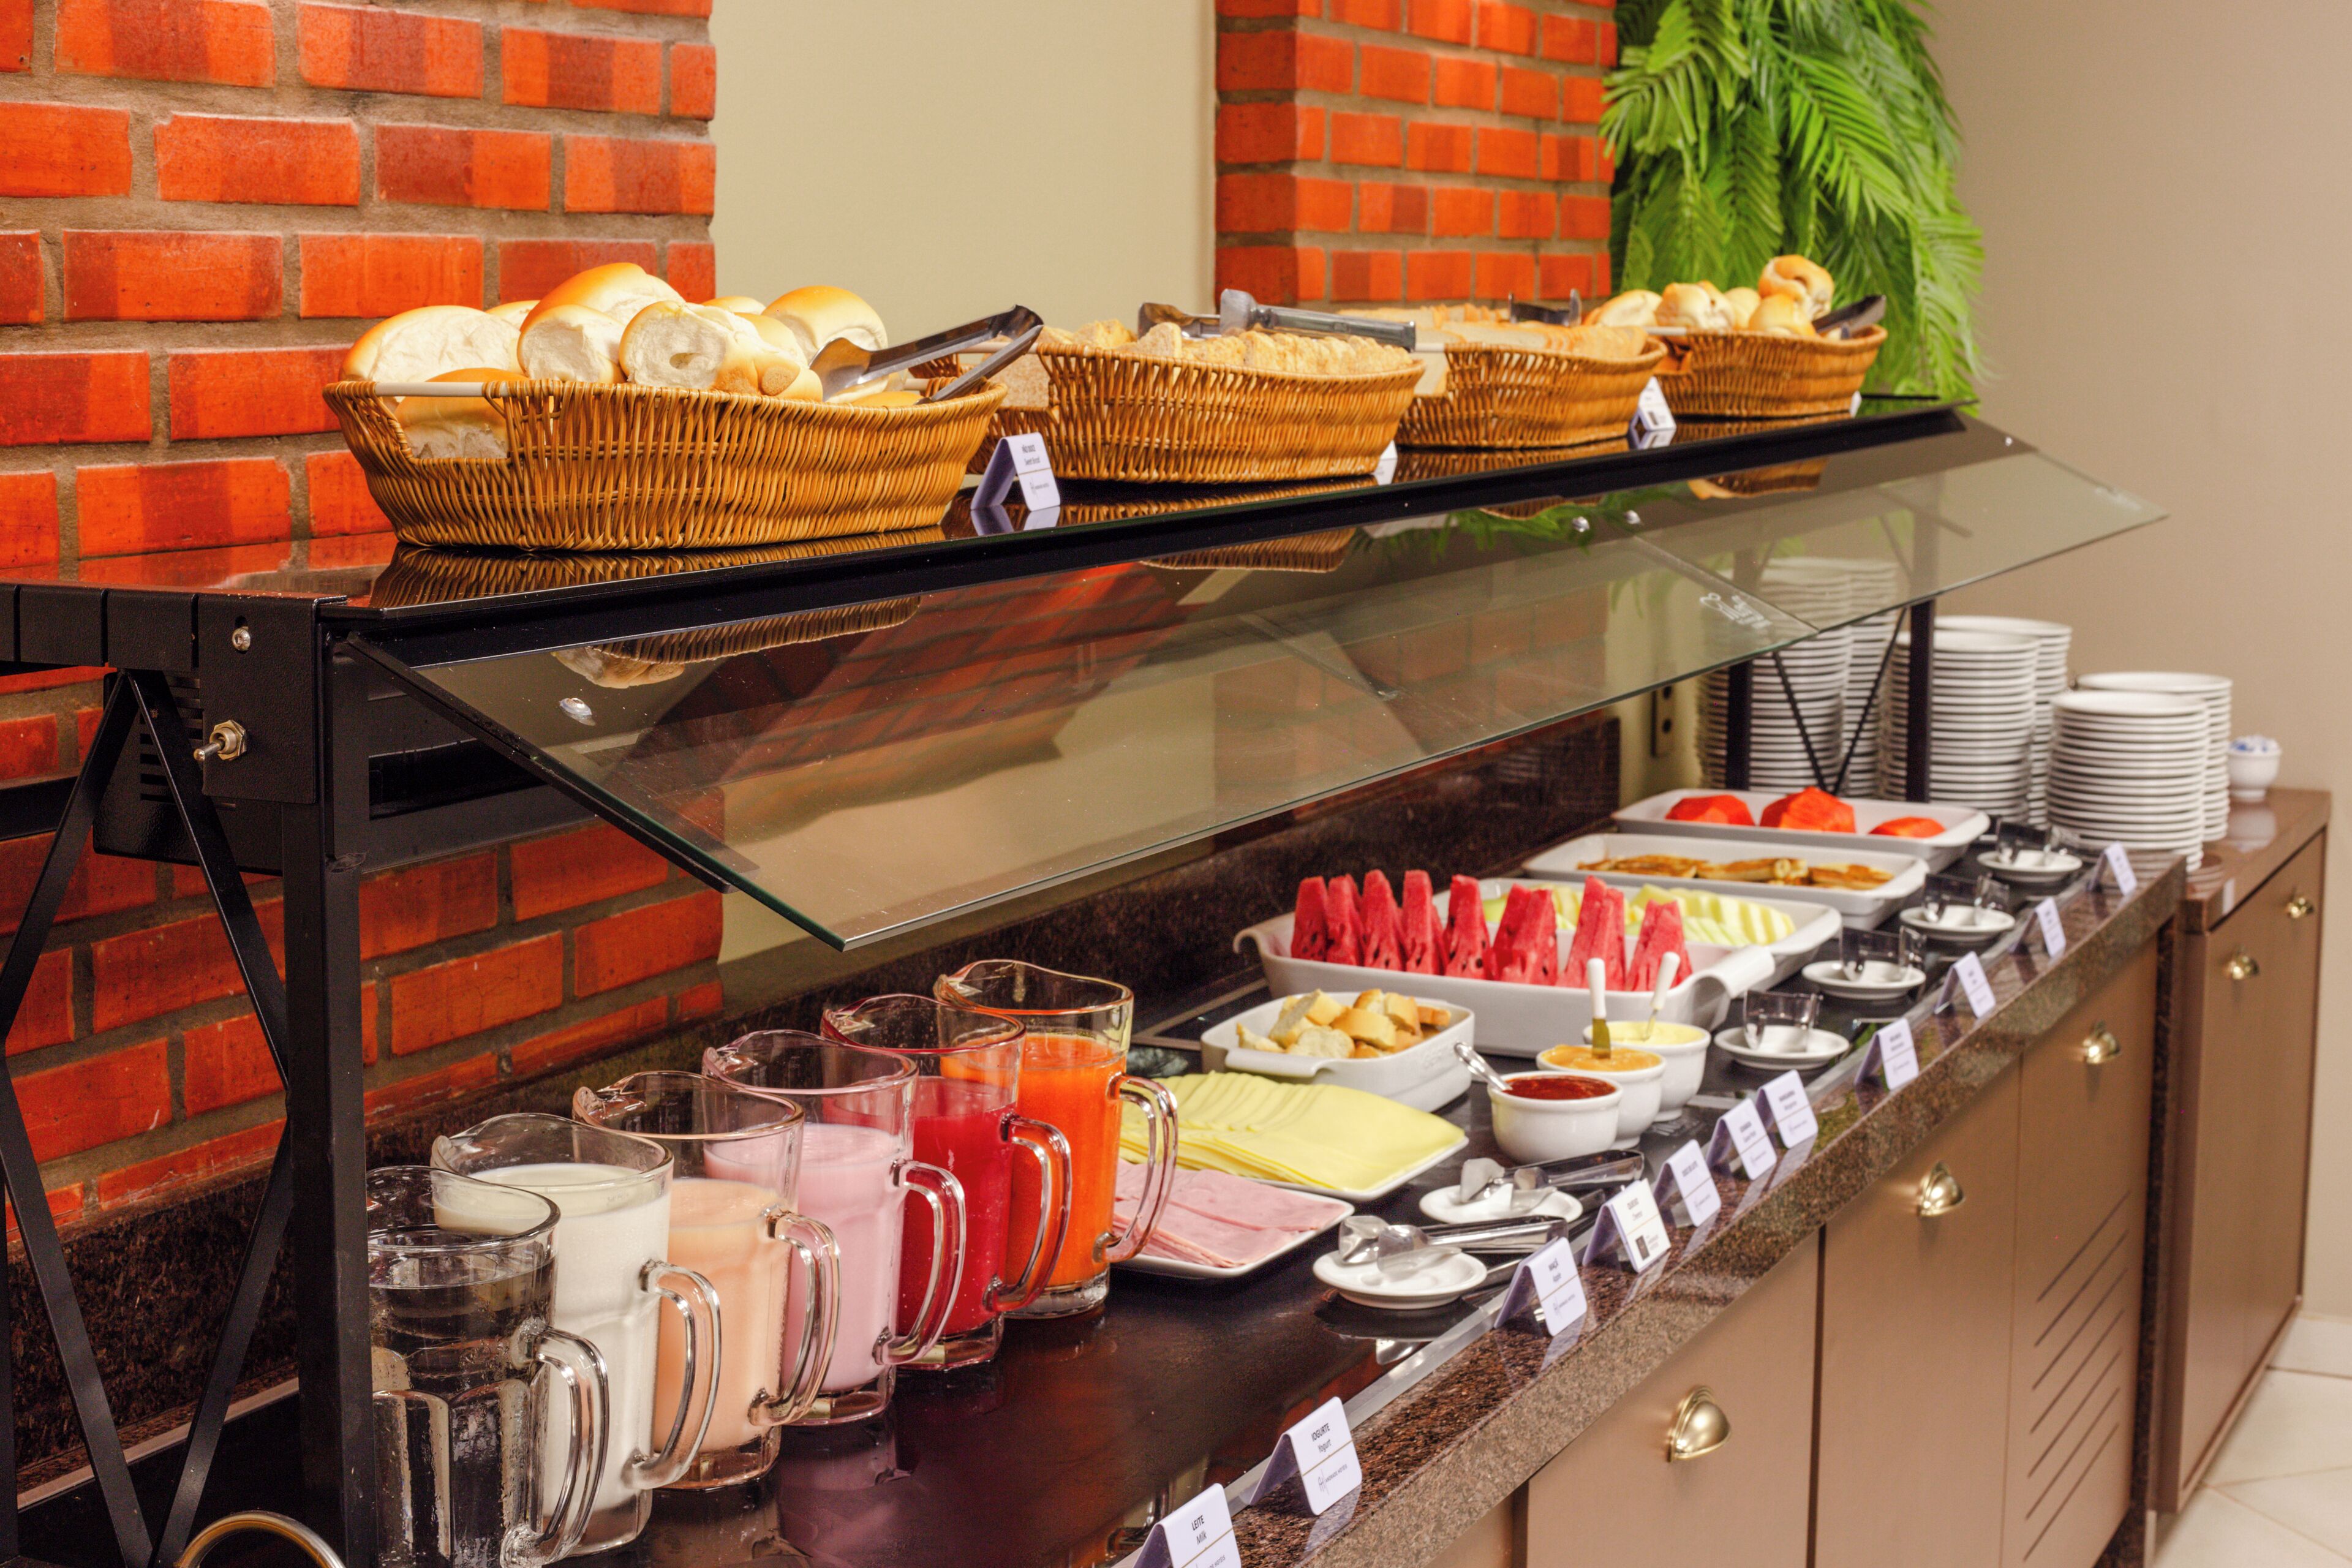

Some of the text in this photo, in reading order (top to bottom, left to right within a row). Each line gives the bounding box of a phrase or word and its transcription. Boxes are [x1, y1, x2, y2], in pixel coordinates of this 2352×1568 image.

[1311, 1423, 1330, 1442] IOGURTE
[1317, 1439, 1332, 1453] Yogurt
[1191, 1515, 1205, 1531] LEITE
[1196, 1530, 1207, 1545] Milk
